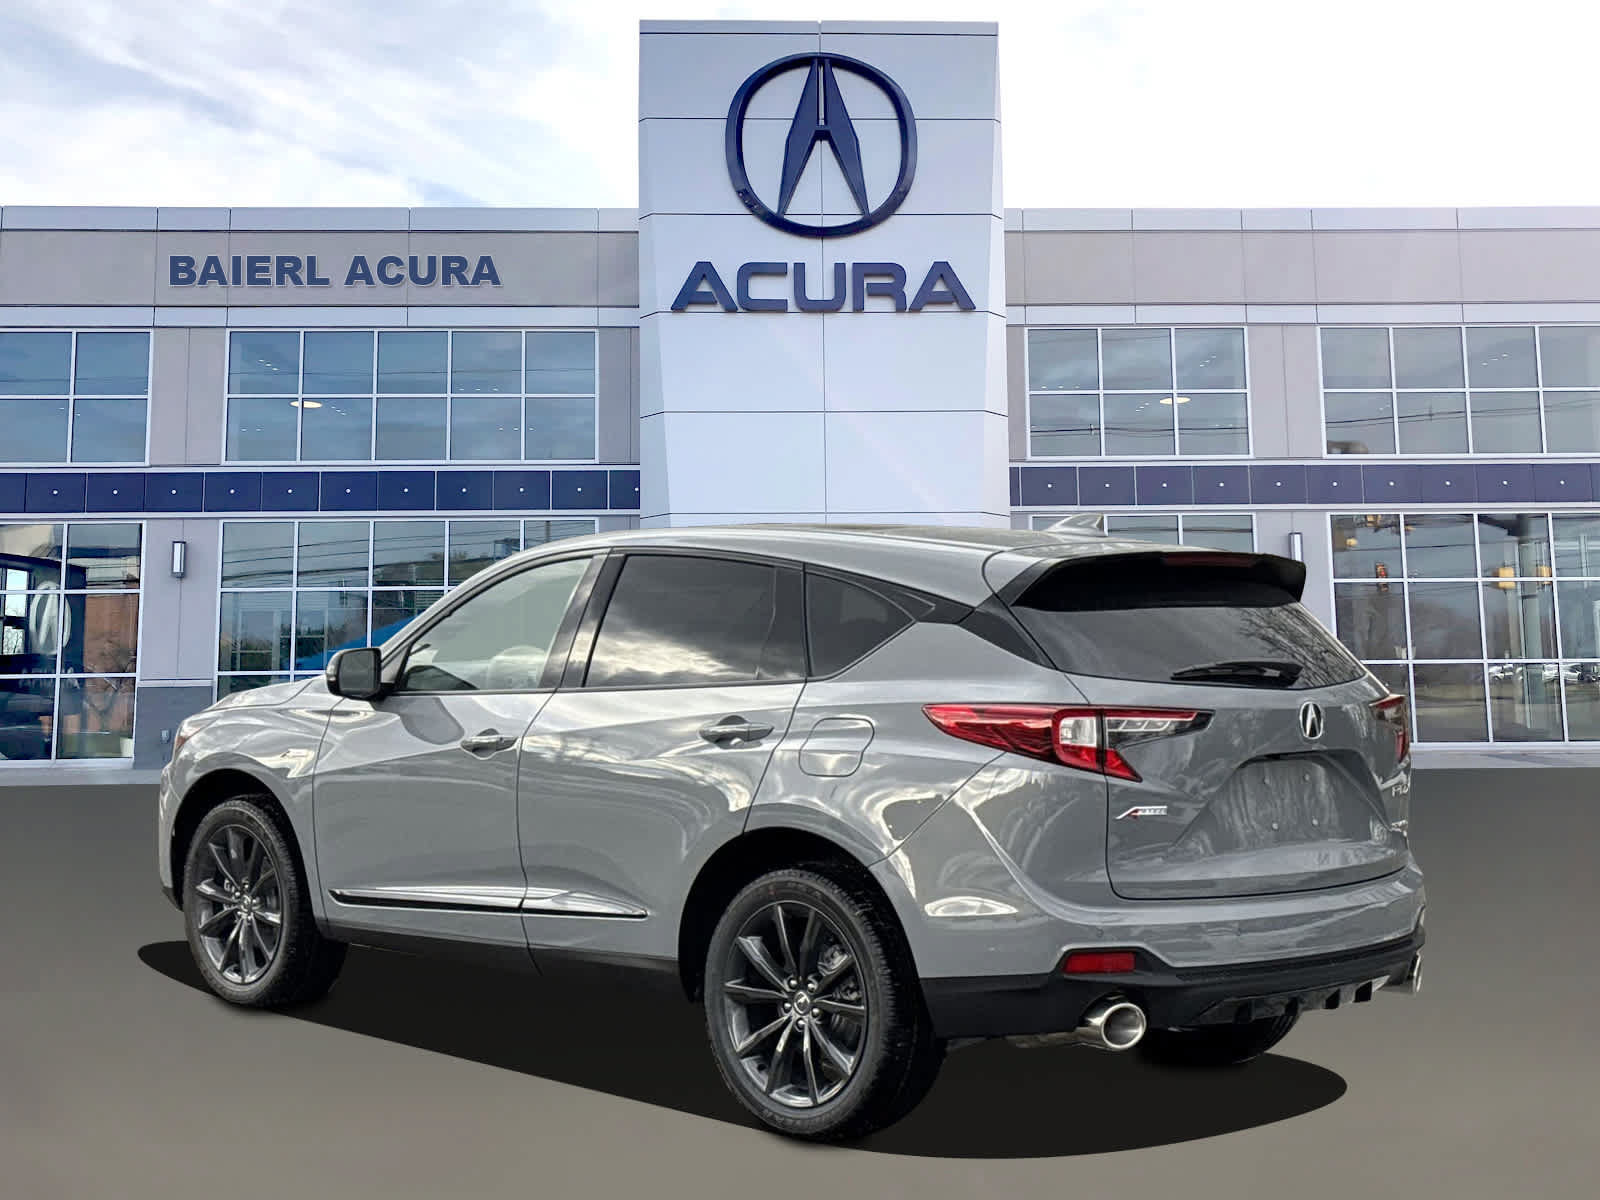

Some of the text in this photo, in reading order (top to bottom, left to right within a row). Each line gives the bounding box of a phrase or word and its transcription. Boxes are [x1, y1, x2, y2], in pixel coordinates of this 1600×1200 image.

[168, 255, 502, 287] BAIERL ACURA
[670, 260, 977, 312] ACURA
